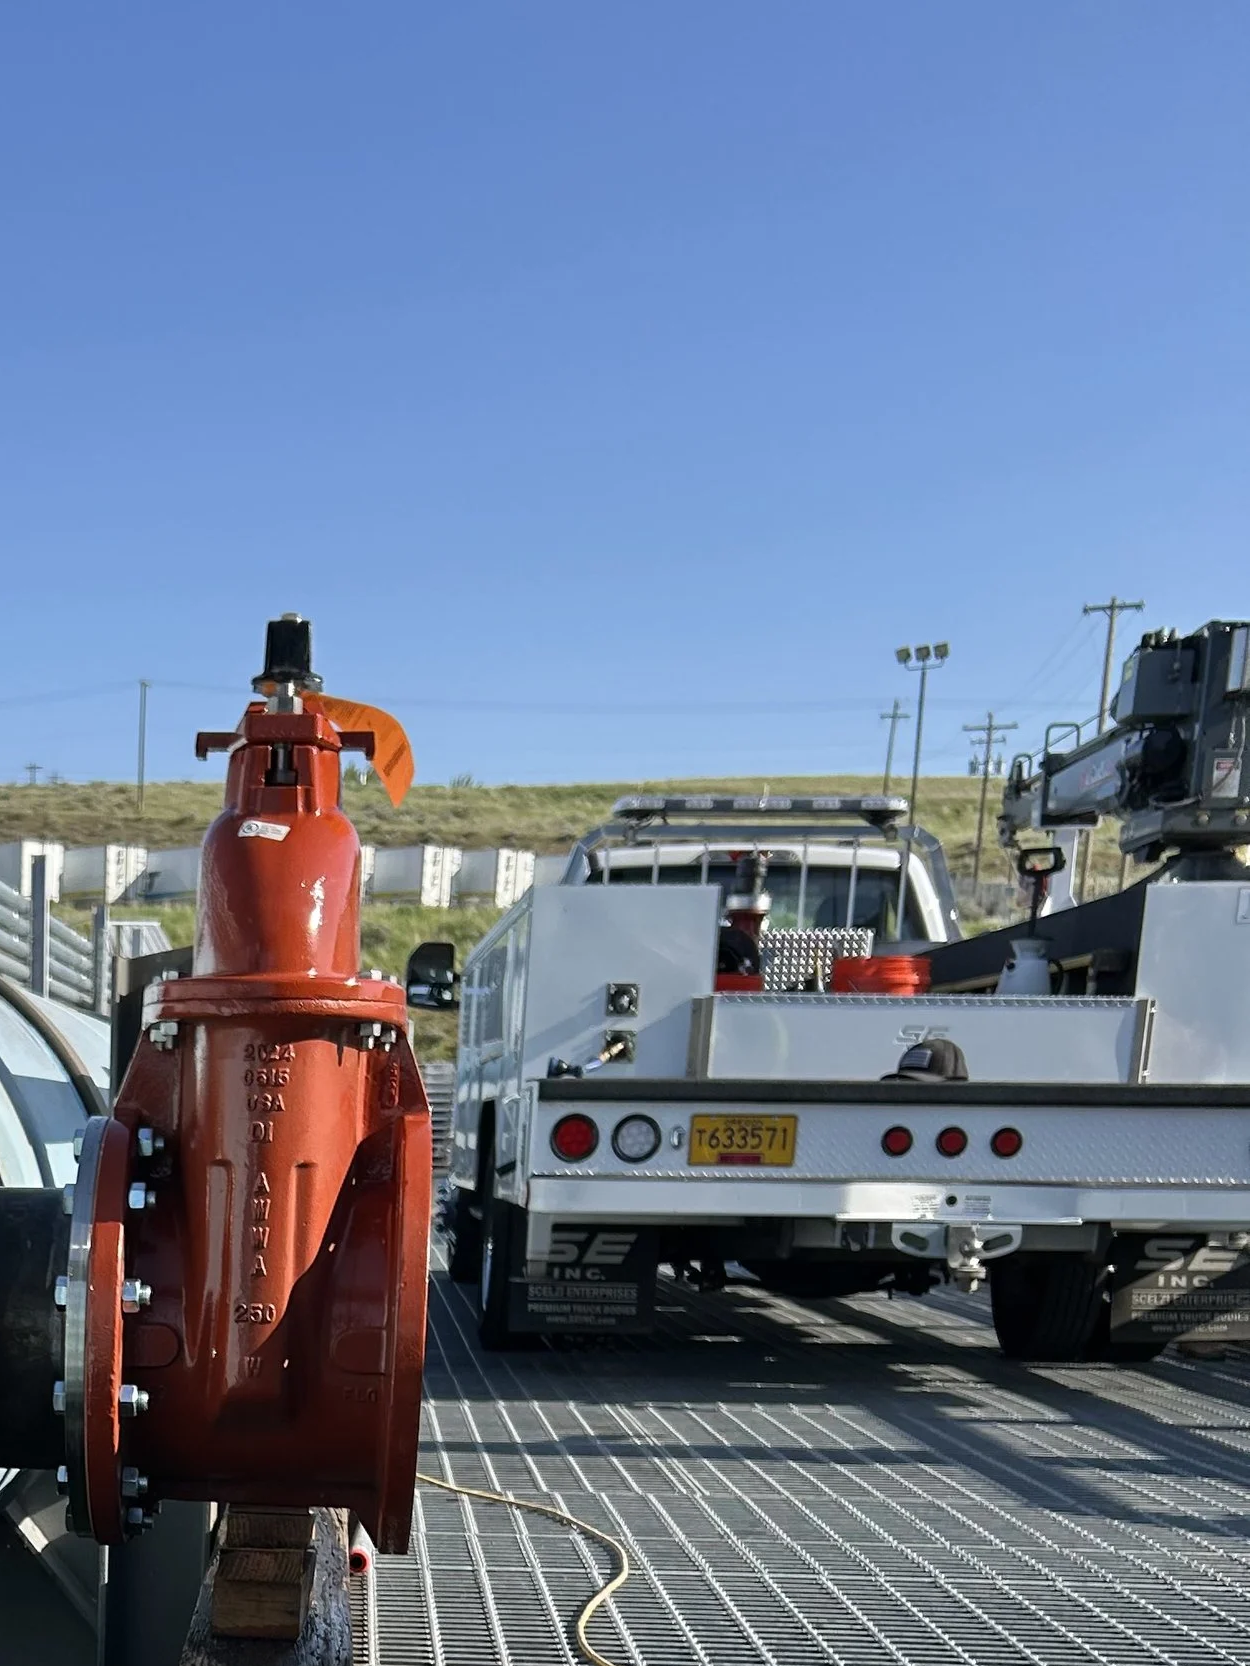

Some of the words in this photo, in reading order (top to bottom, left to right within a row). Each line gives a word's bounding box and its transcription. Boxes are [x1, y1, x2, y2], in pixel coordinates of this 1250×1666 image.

[244, 1043, 296, 1061] 2024
[245, 1068, 290, 1087] 0515
[247, 1093, 285, 1111] USA
[251, 1121, 274, 1142] DI
[696, 1127, 787, 1150] T633571
[1134, 1239, 1243, 1271] SE
[553, 1267, 606, 1281] INC.
[235, 1303, 276, 1324] 250
